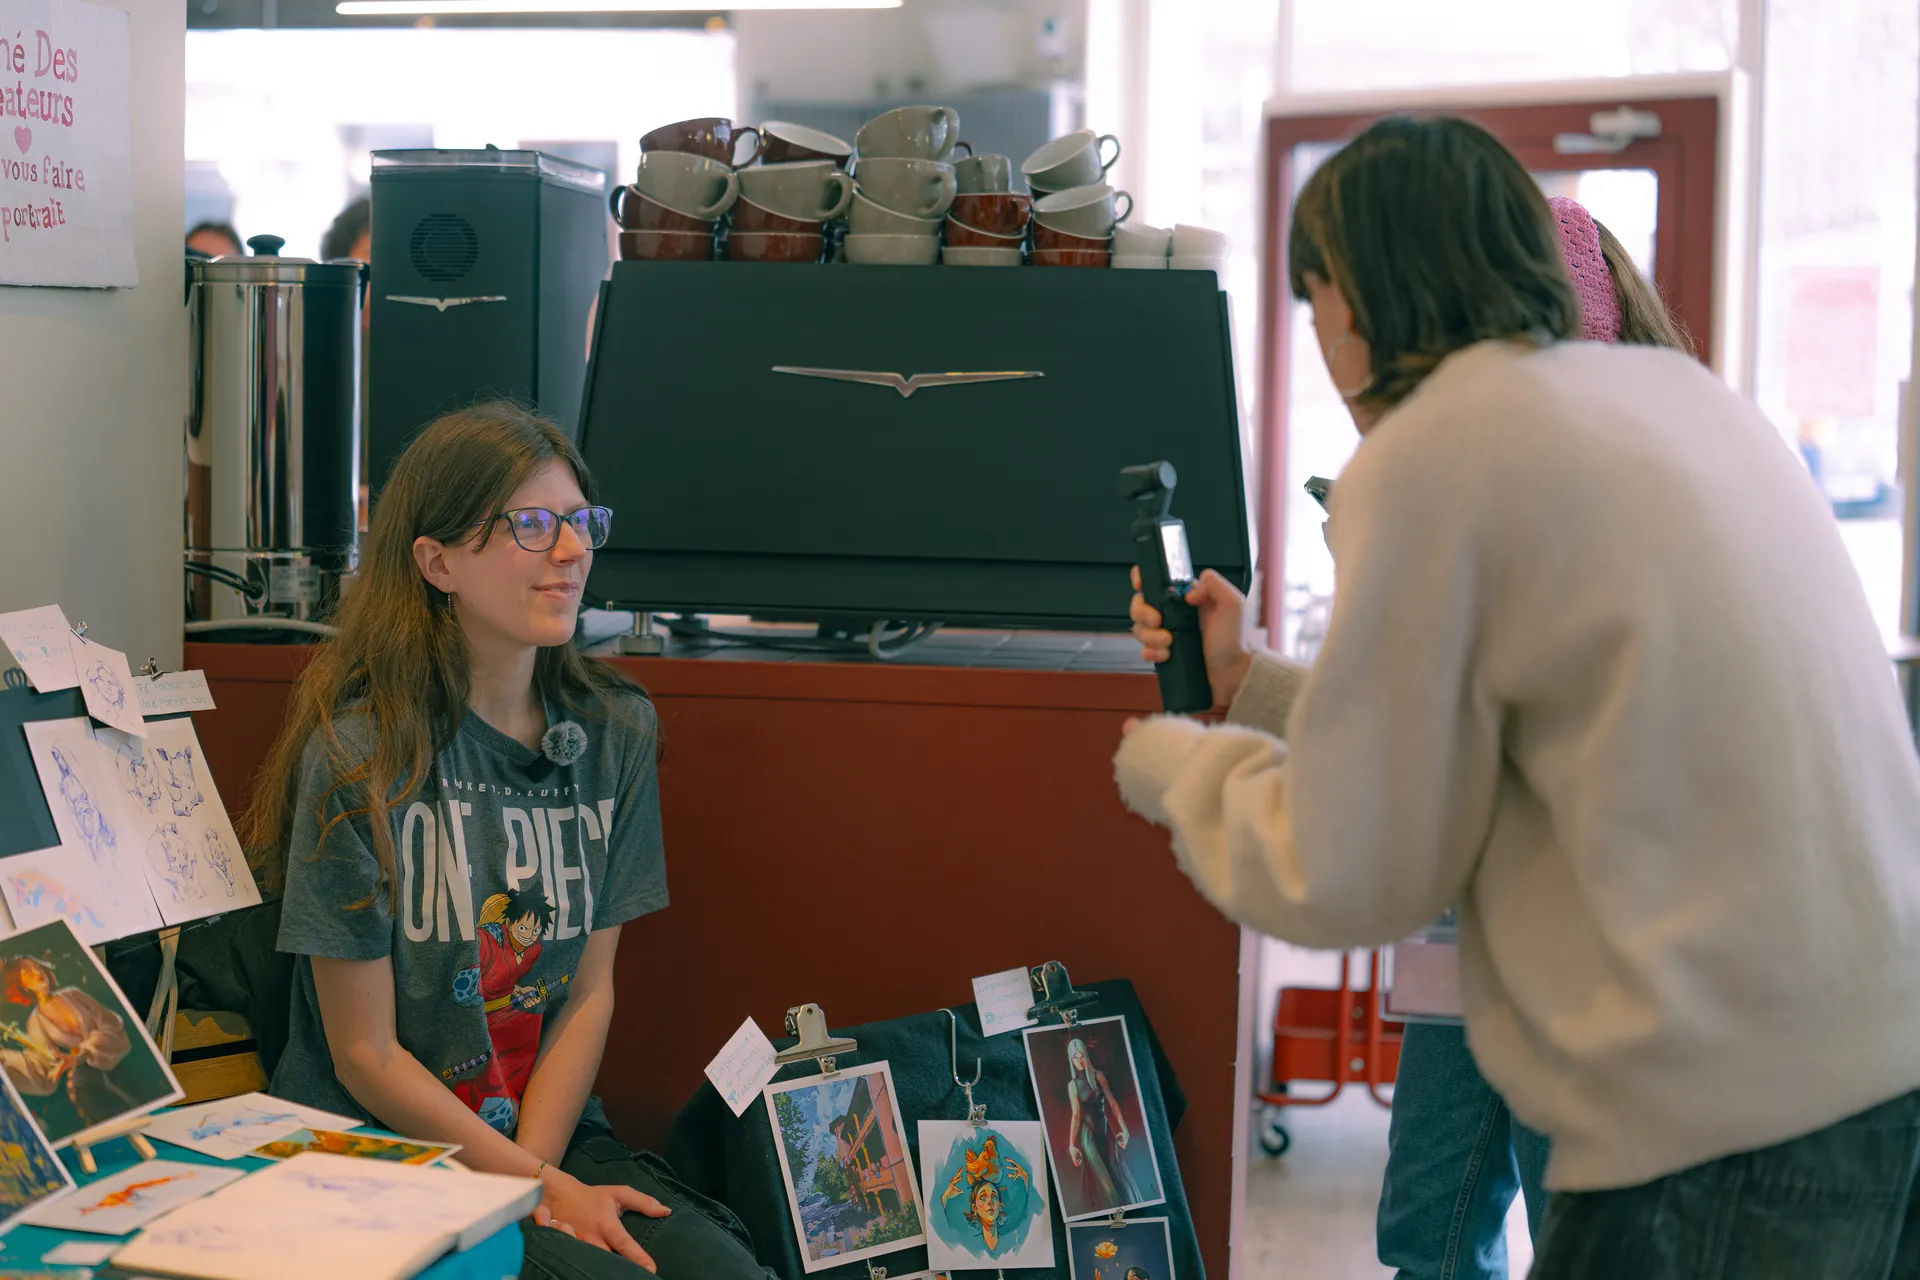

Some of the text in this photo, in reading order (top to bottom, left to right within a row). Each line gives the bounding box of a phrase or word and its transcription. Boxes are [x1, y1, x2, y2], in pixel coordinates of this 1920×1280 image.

[34, 29, 78, 84] Des
[1, 155, 86, 192] vous faire
[1, 197, 66, 243] portrait
[402, 797, 616, 943] ON PIEC
[707, 1031, 756, 1085] Impressions
